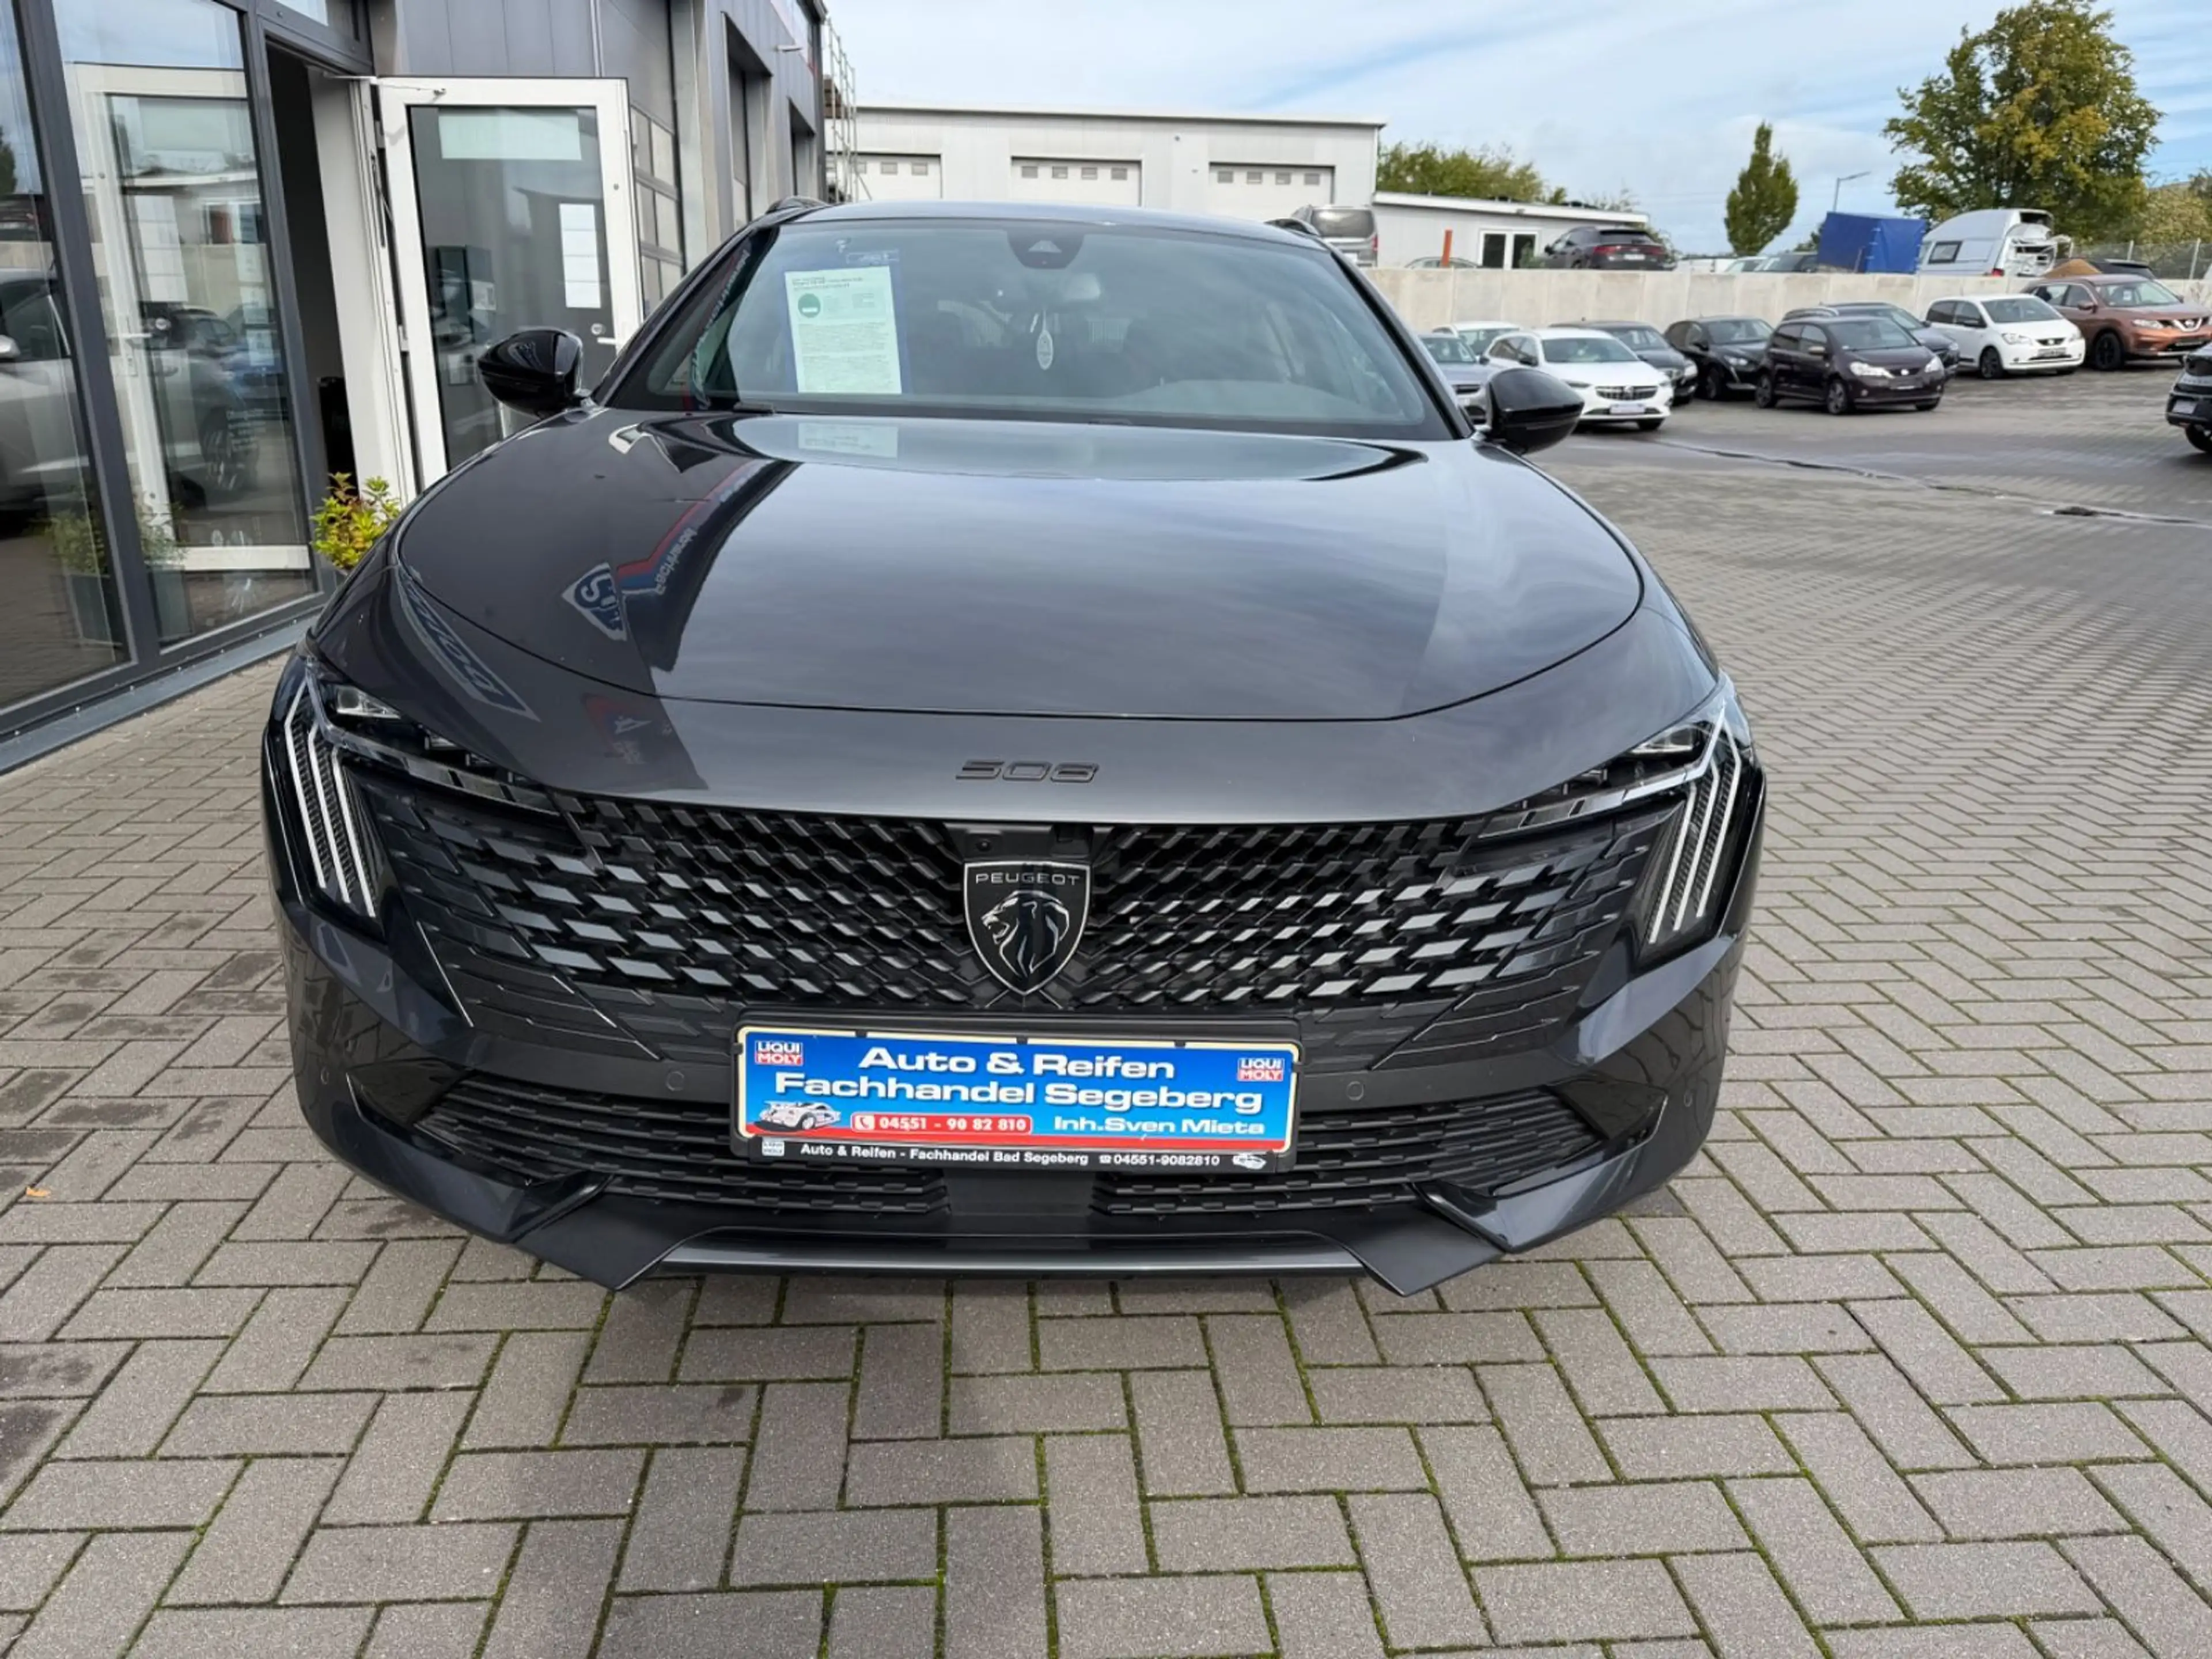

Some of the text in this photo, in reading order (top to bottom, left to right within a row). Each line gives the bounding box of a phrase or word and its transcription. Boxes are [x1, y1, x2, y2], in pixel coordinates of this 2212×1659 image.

[956, 760, 1099, 783] 508
[975, 872, 1080, 885] PEUGEOT
[757, 1041, 800, 1052] LIQUI
[757, 1053, 801, 1065] MOLY
[858, 1047, 1176, 1079] Auto & Reifen
[1241, 1058, 1283, 1070] LIQUI
[1239, 1070, 1283, 1081] MOLY
[775, 1071, 1263, 1115] Fachhandel Segeberg
[879, 1117, 927, 1131] 04551
[946, 1118, 968, 1131] 90
[972, 1118, 993, 1131] 82
[998, 1118, 1027, 1131] 810
[1181, 1118, 1266, 1134] Mieta
[801, 1143, 834, 1156] Auto
[837, 1145, 848, 1157] &
[851, 1145, 896, 1159] Reifen
[909, 1149, 990, 1162] Fachhandel
[993, 1151, 1020, 1162] Bad
[1023, 1152, 1089, 1165] Segeberg
